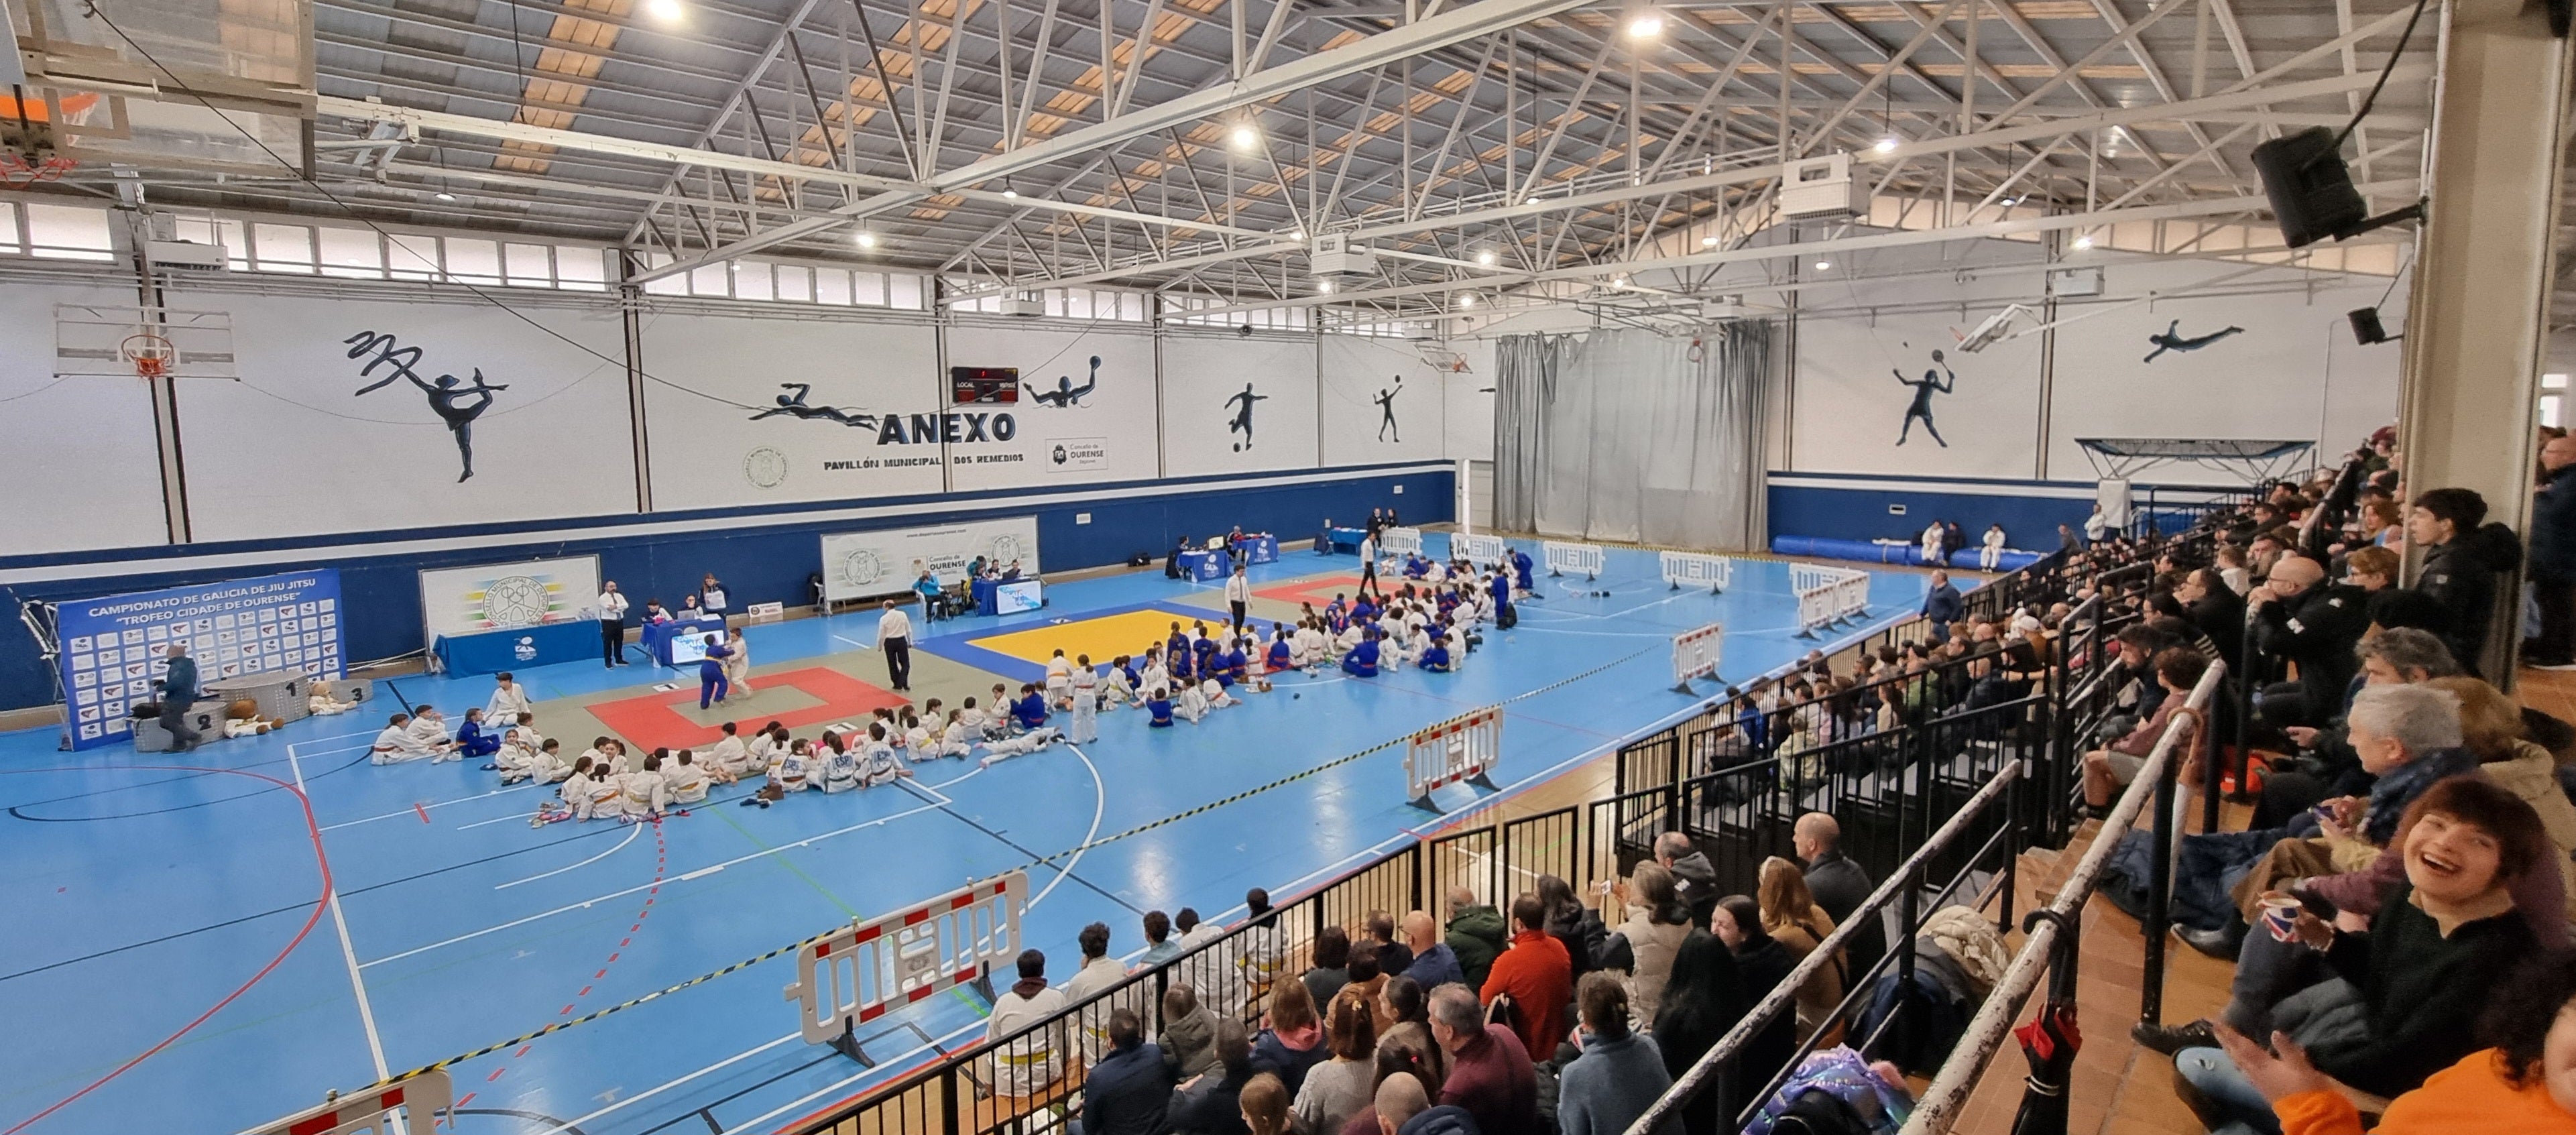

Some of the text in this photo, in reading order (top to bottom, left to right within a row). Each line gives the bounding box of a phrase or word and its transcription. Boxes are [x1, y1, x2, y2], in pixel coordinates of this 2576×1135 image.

[876, 413, 1016, 445] ANEXO
[1070, 450, 1104, 459] OURENSE
[824, 454, 1024, 471] PAVILLÓN MUNICIPAL DOS REMEDIOS
[930, 560, 965, 571] OURENSE
[491, 578, 526, 592] MUNICIPAL
[89, 579, 316, 617] CAMPIONATO DE GALICIA DE JIU JITSU
[536, 587, 547, 617] DEPORTES
[177, 604, 223, 617] CIDADE
[225, 601, 241, 610] DE
[485, 593, 500, 623] CONSELLO
[286, 682, 296, 697] 1
[351, 687, 363, 701] 3
[198, 715, 211, 730] 2
[835, 756, 850, 767] ESP
